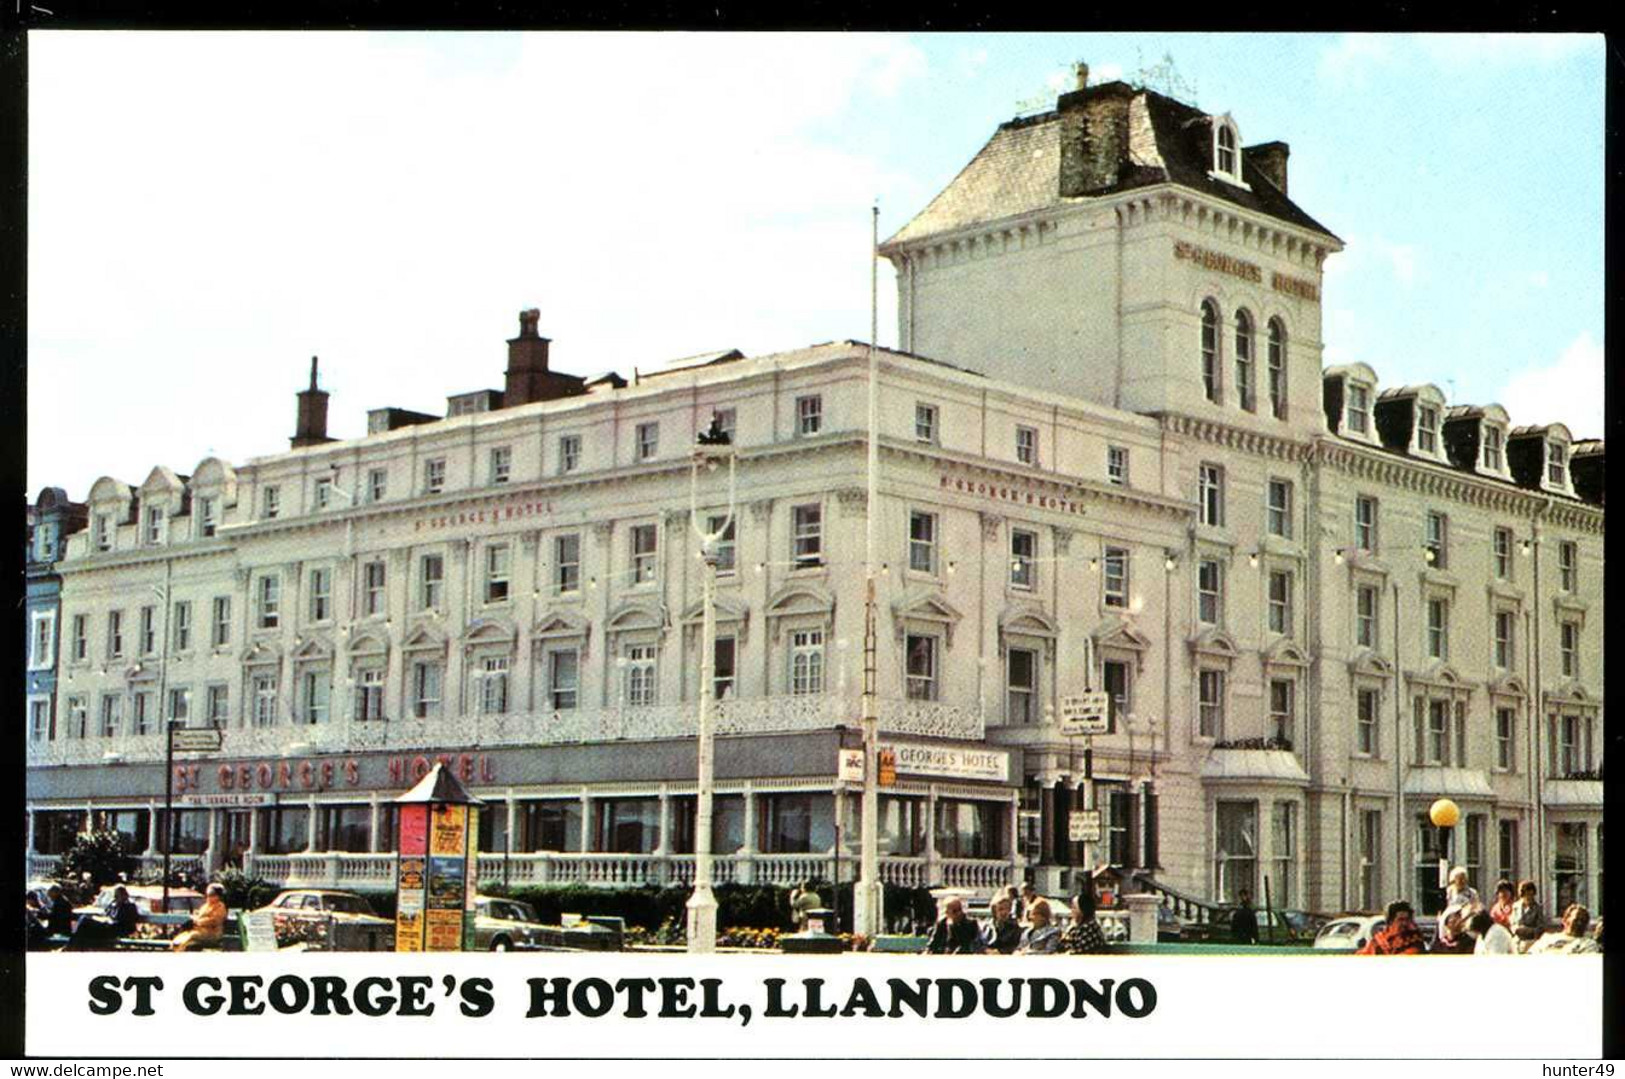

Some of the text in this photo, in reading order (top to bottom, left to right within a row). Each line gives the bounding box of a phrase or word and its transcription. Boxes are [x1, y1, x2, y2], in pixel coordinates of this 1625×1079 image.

[1192, 245, 1263, 284] GEORGES
[1272, 271, 1318, 302] HOTEL
[430, 509, 499, 529] GEORGES
[505, 502, 552, 519] HOTEL
[1039, 495, 1087, 515] HOTEL
[900, 748, 956, 766] GEORGES
[962, 753, 1000, 769] HOTEL
[174, 763, 201, 790] ST
[217, 756, 360, 790] GEORGE'S
